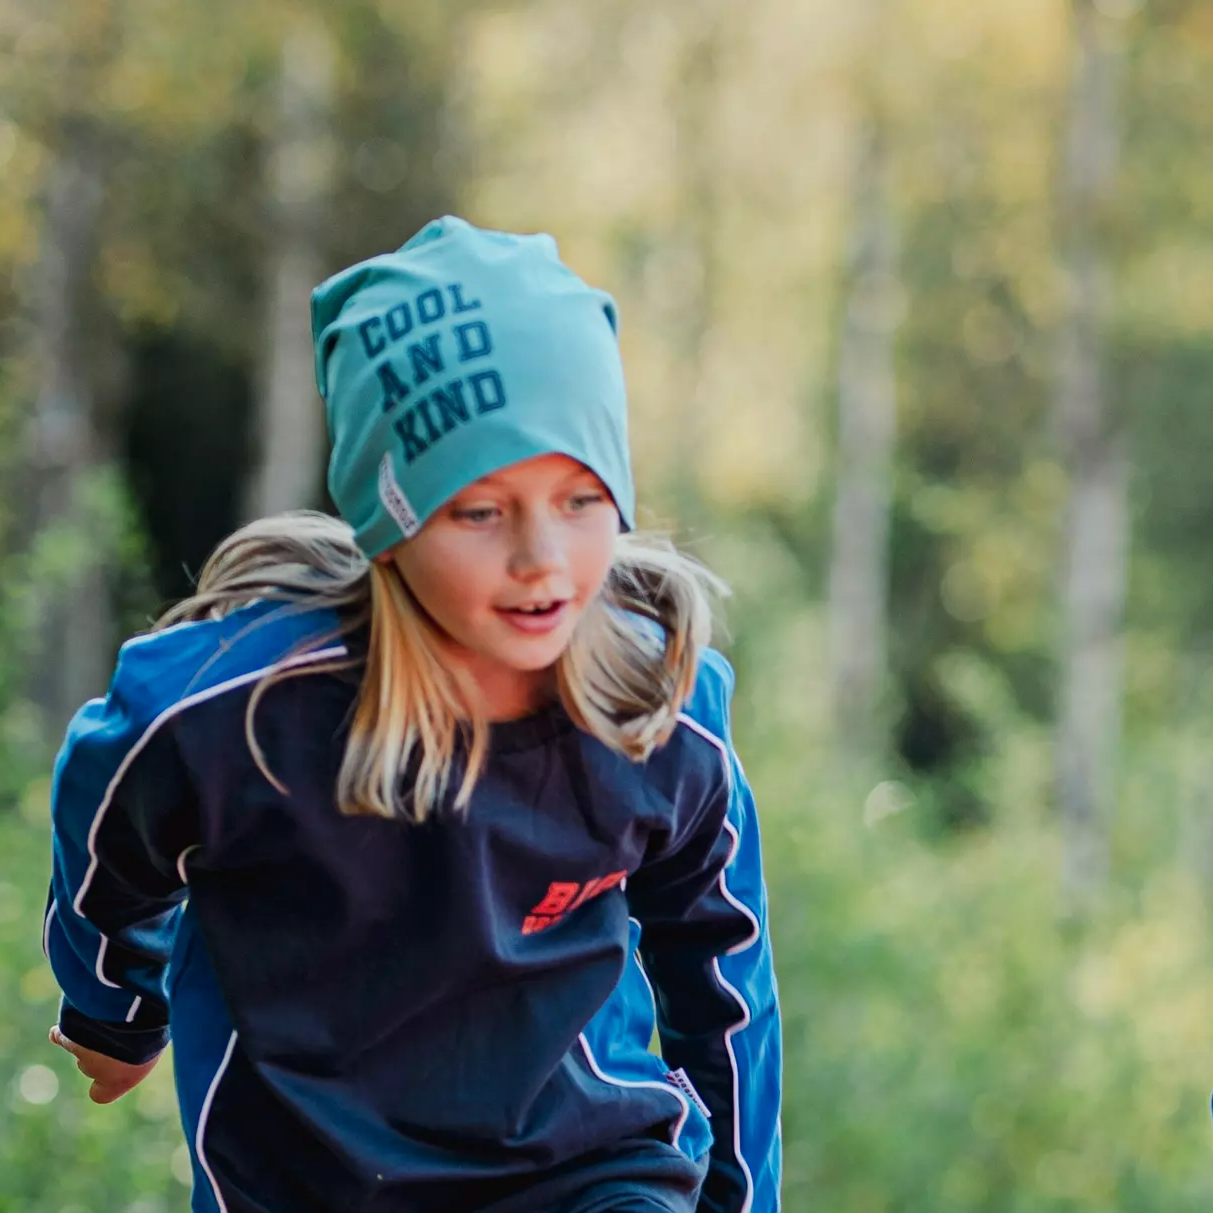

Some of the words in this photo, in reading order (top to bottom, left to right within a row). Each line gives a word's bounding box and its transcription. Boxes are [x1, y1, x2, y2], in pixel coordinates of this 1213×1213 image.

[358, 283, 482, 359] COOL
[376, 321, 493, 413] AND
[393, 370, 507, 465] KIND
